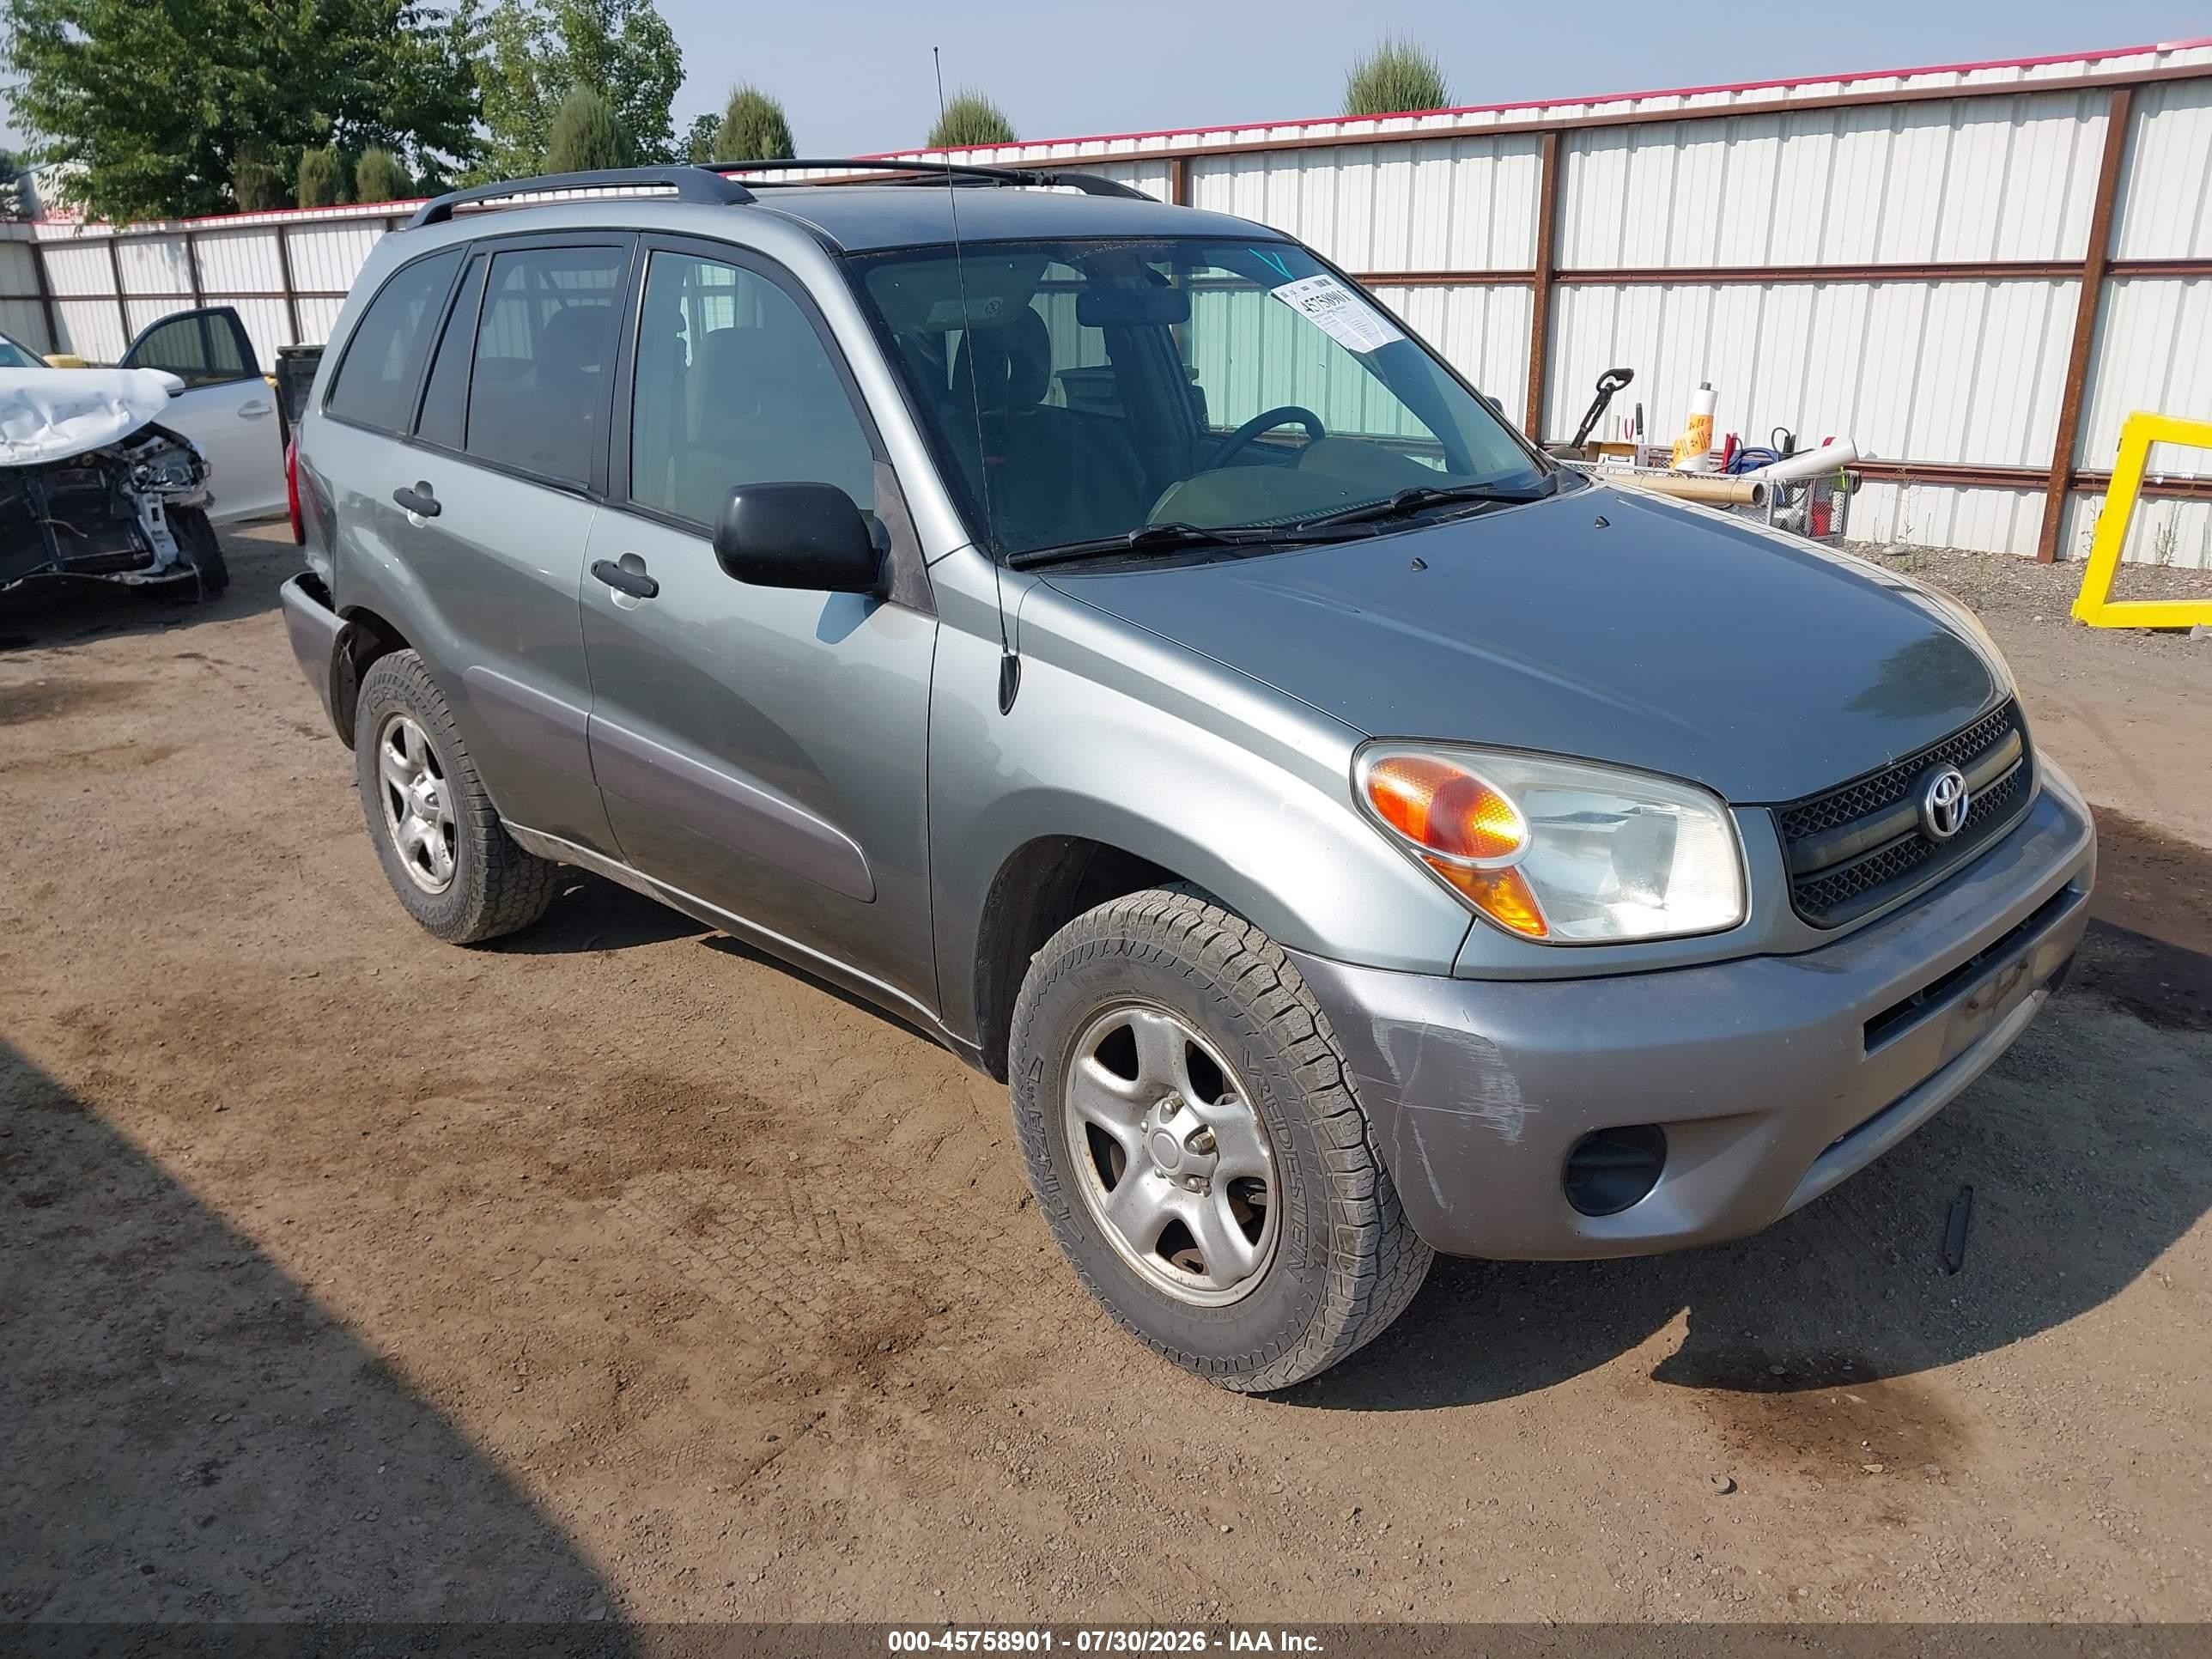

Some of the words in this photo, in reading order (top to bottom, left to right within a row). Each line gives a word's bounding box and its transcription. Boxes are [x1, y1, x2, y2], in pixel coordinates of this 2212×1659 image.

[1299, 289, 1352, 313] 45758901
[1029, 1110, 1071, 1223] PINZA
[1239, 1046, 1310, 1284] VREDESTEIN
